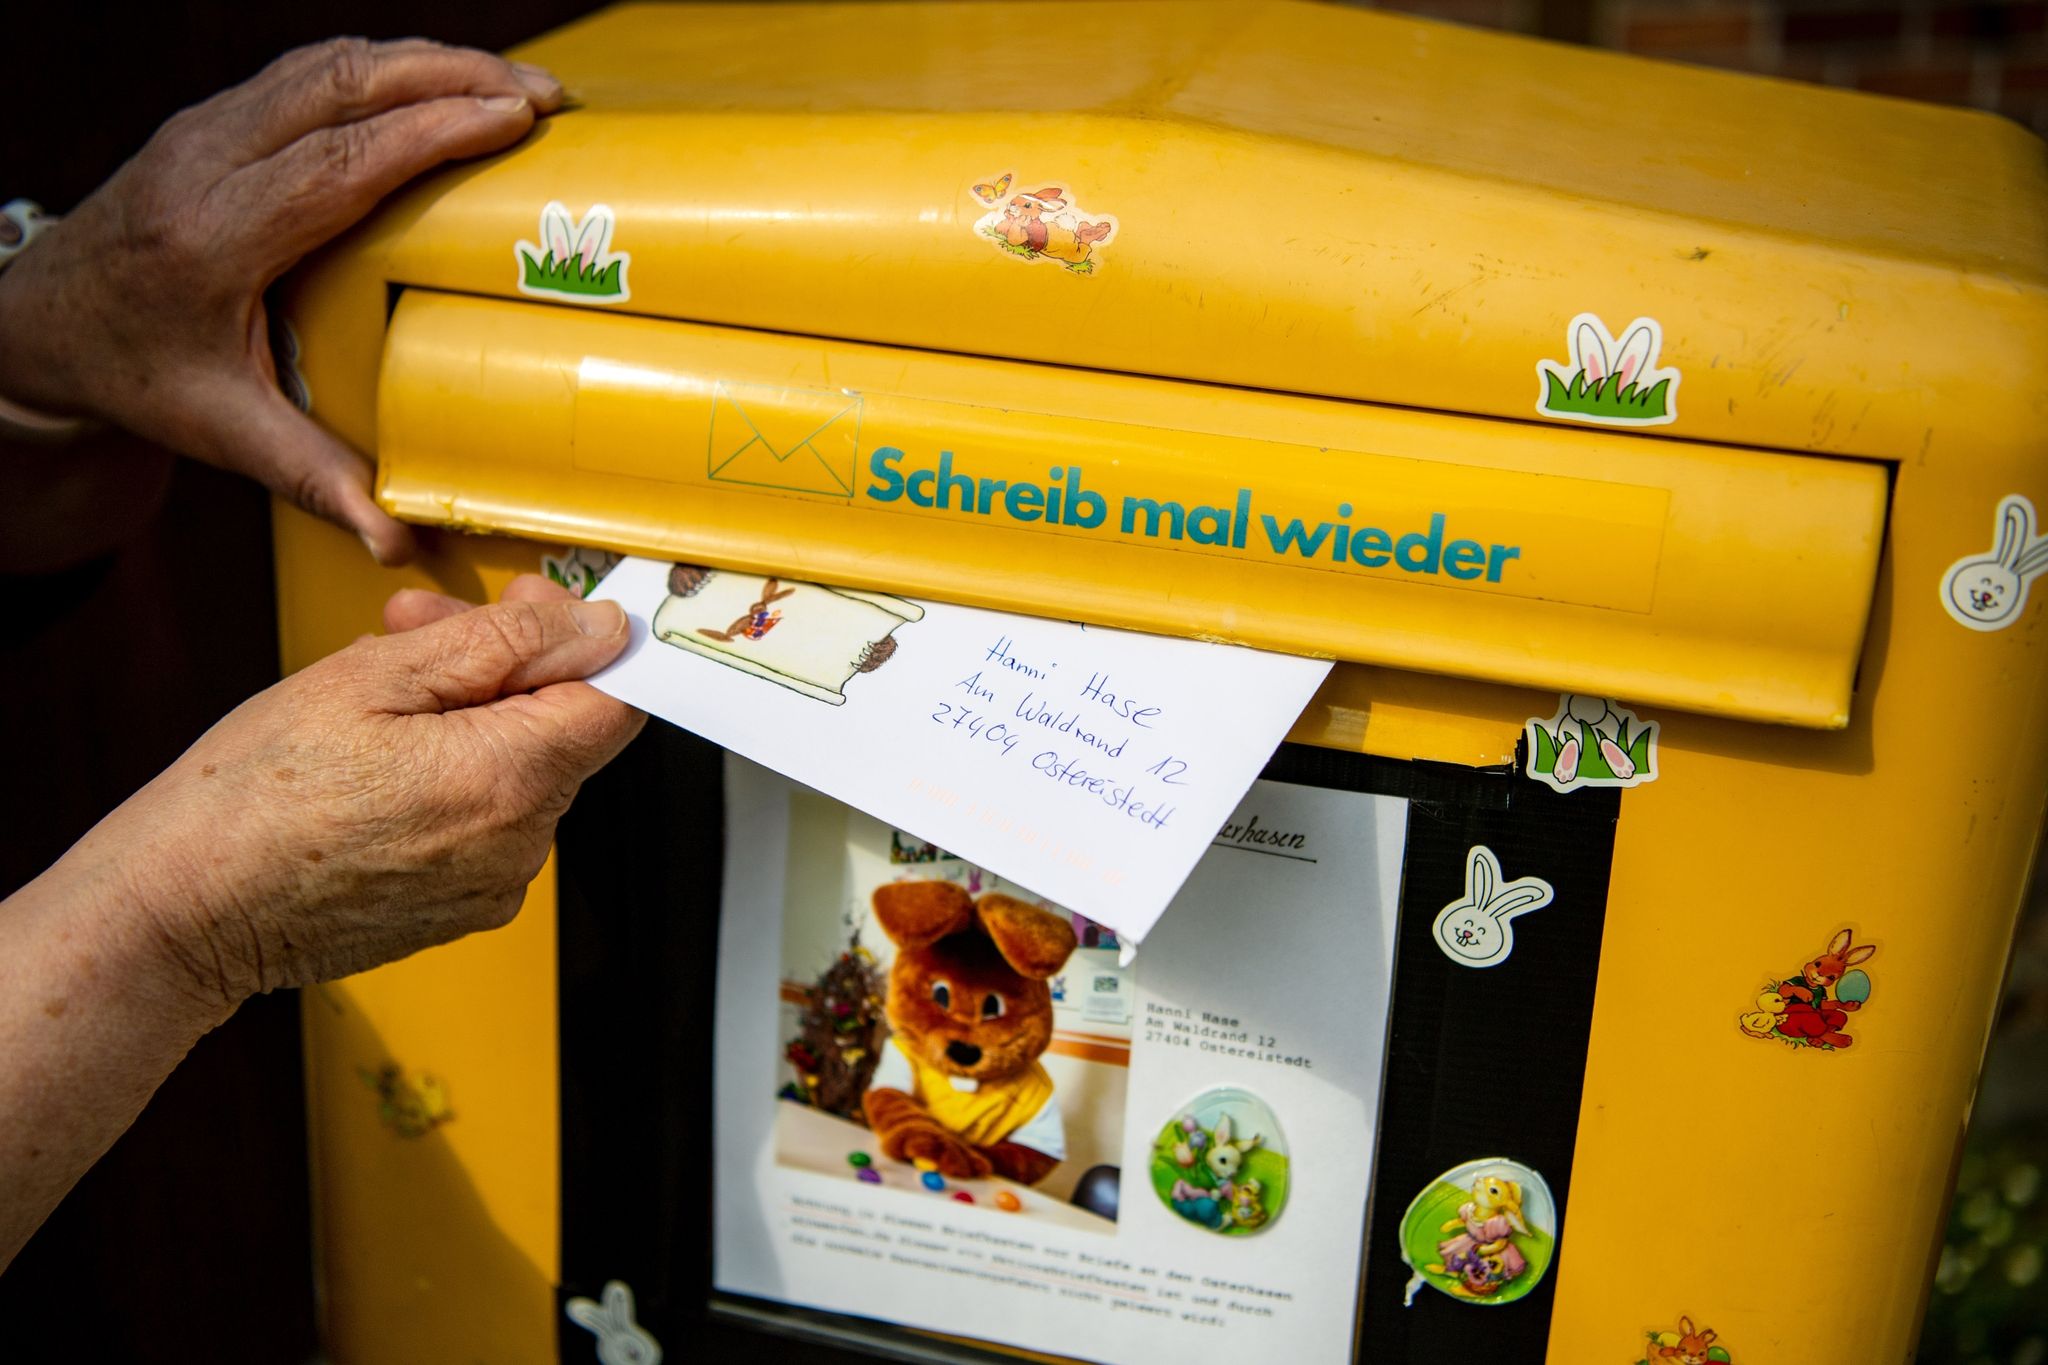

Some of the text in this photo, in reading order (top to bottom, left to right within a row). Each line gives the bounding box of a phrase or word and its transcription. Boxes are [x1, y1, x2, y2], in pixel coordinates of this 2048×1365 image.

[866, 447, 1521, 583] Schreib mal wieder
[955, 672, 1190, 786] Am Waldrand 12
[985, 634, 1161, 729] Hanni Hase
[932, 702, 1177, 830] 27404 Ostereistedt
[1145, 1017, 1276, 1049] Am Waldrand 12
[1145, 1031, 1312, 1069] 27404 Ostereistedt
[1147, 1003, 1239, 1028] Hanni Hase
